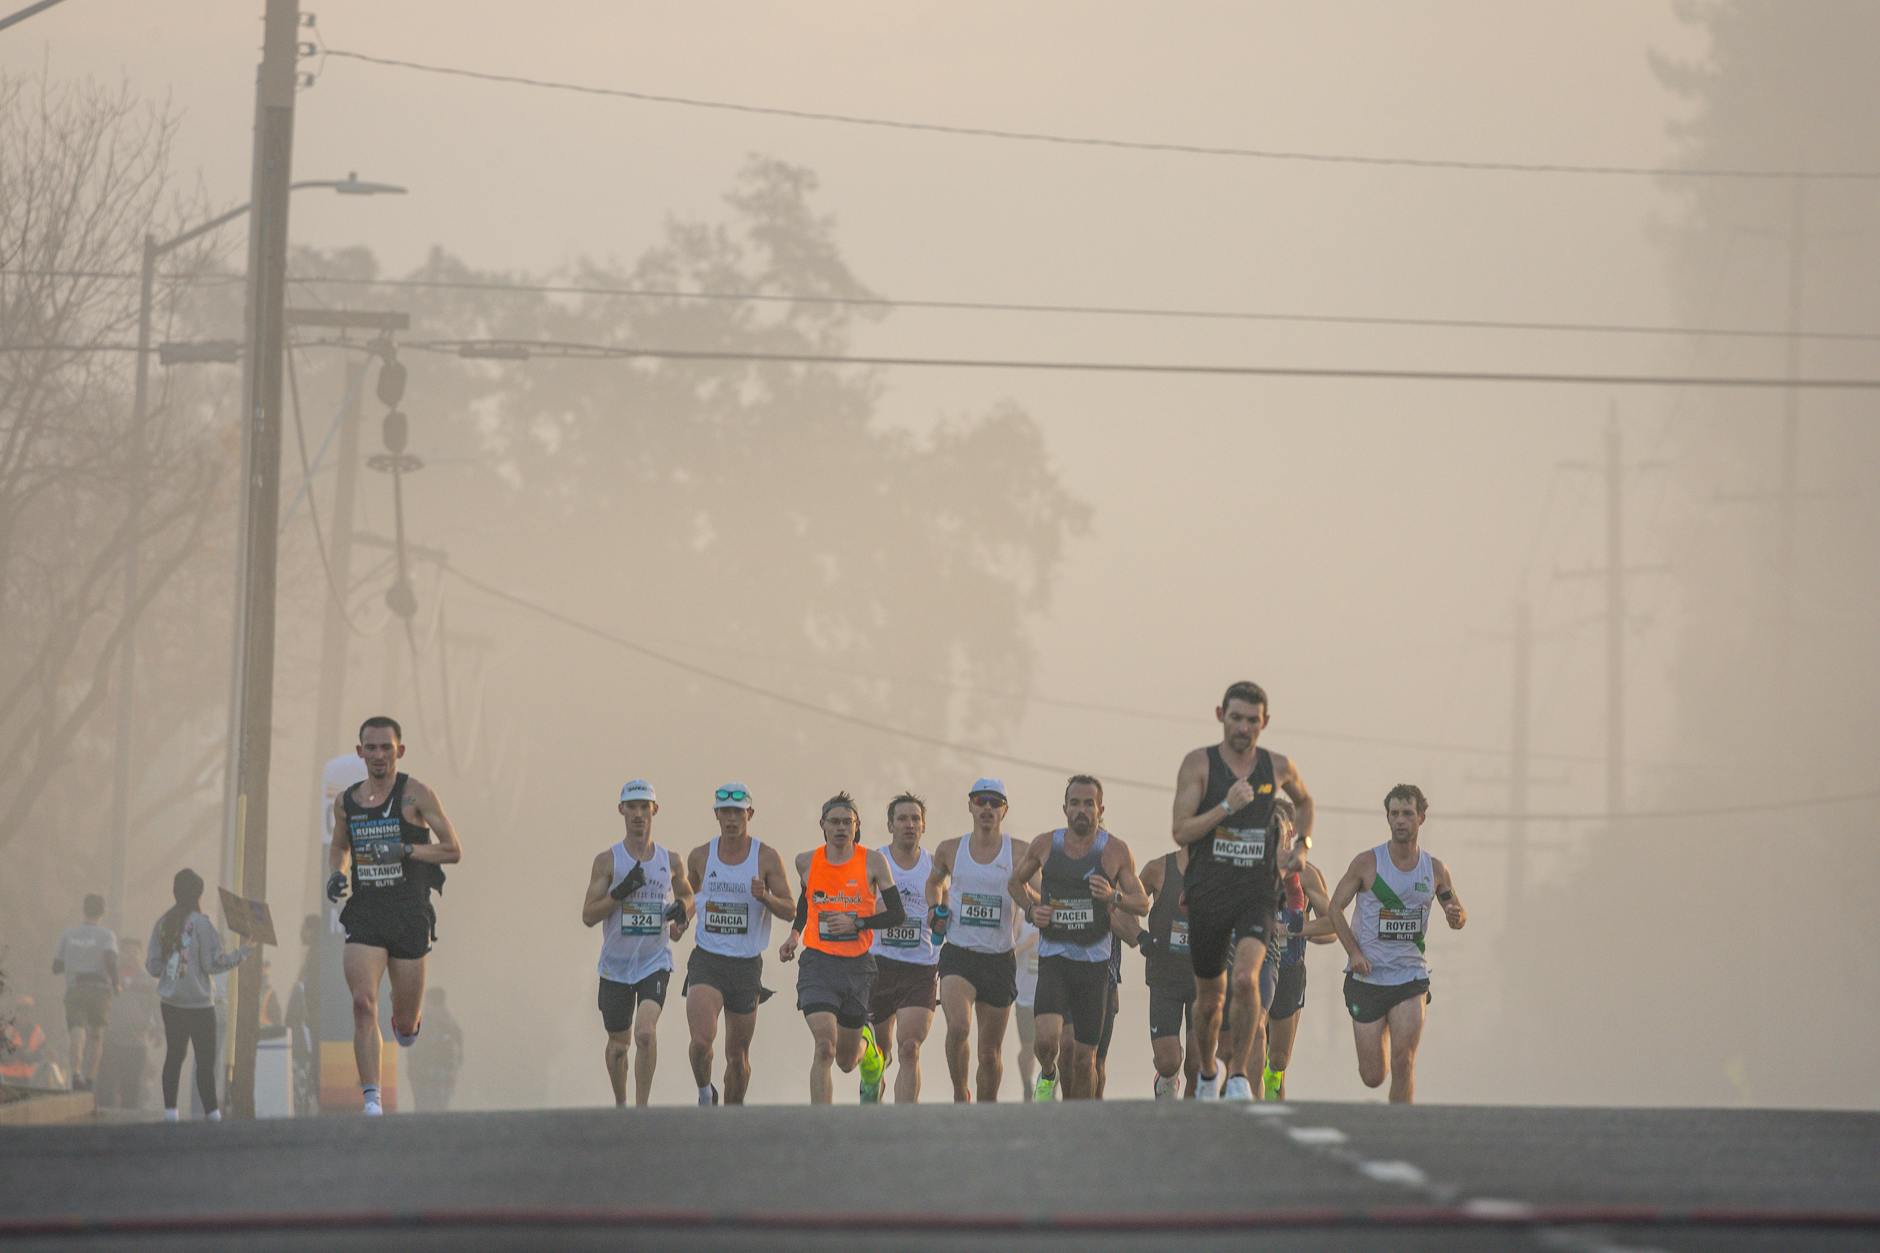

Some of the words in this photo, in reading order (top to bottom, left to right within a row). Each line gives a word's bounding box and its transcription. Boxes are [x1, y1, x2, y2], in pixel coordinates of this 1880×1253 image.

[356, 824, 400, 836] RUNNING
[1215, 841, 1263, 855] MCCANN
[1233, 858, 1253, 866] ELITE
[358, 865, 401, 878] SULTANOV
[966, 906, 993, 918] 4561
[1056, 911, 1087, 921] PACER
[631, 915, 653, 926] 324
[710, 914, 743, 925] GARCIA
[1386, 921, 1417, 931] ROYER
[887, 928, 915, 939] 8309
